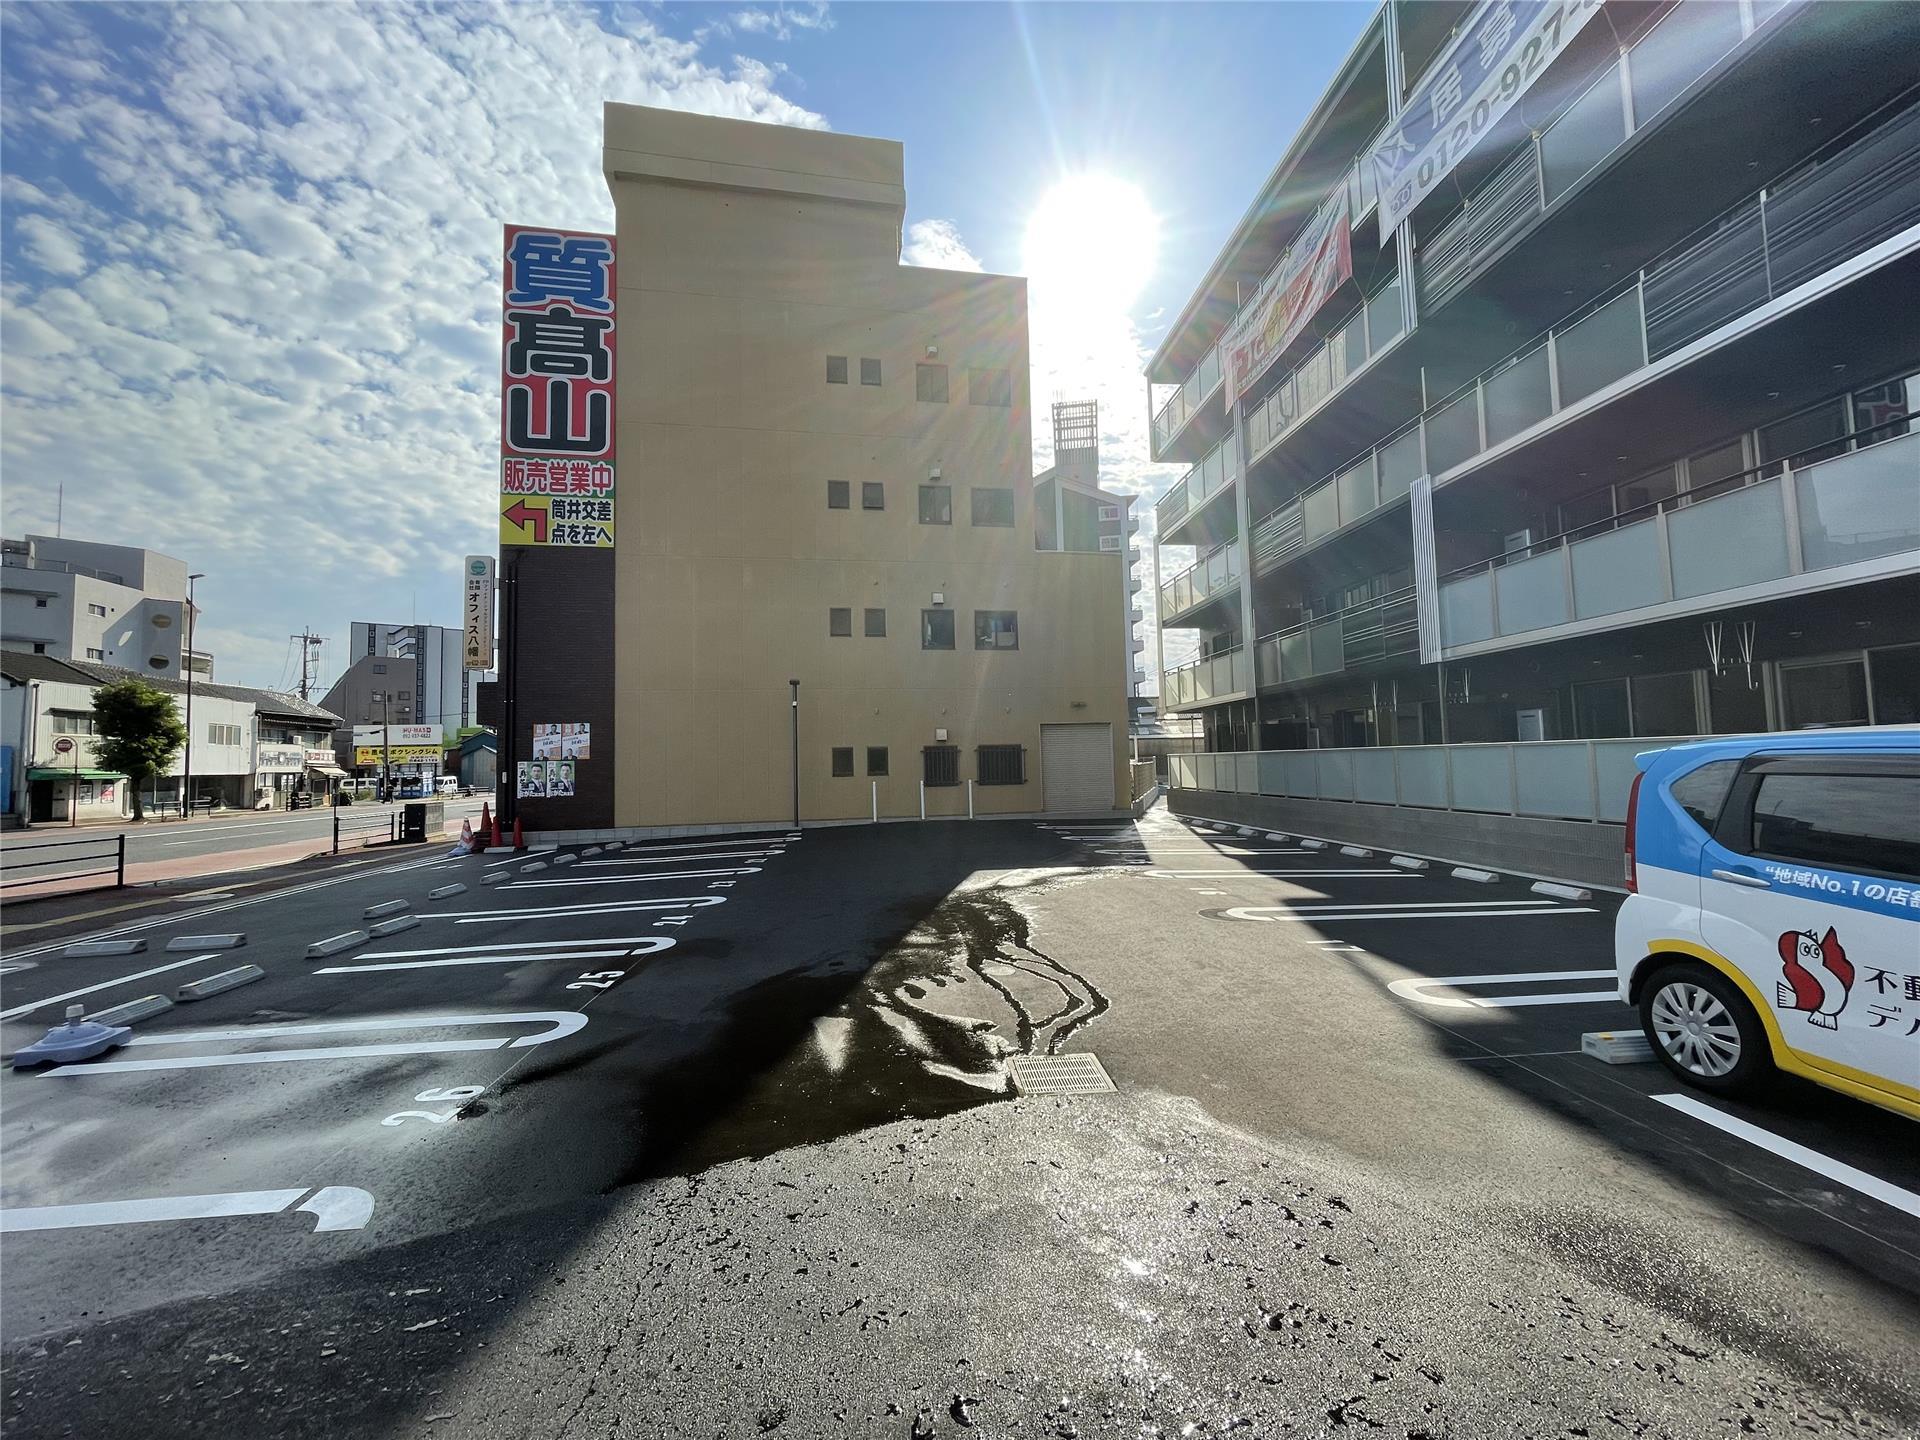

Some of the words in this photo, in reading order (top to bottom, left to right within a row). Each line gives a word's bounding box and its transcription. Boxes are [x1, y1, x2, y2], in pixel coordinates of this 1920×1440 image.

[1417, 0, 1597, 189] 0120-927-
[502, 459, 614, 496] 販売営業中
[550, 498, 612, 522] 筒井交差
[550, 522, 612, 545] 点を左へ
[467, 592, 480, 657] オフィス八幡
[565, 969, 626, 991] 25
[380, 1084, 486, 1128] 26
